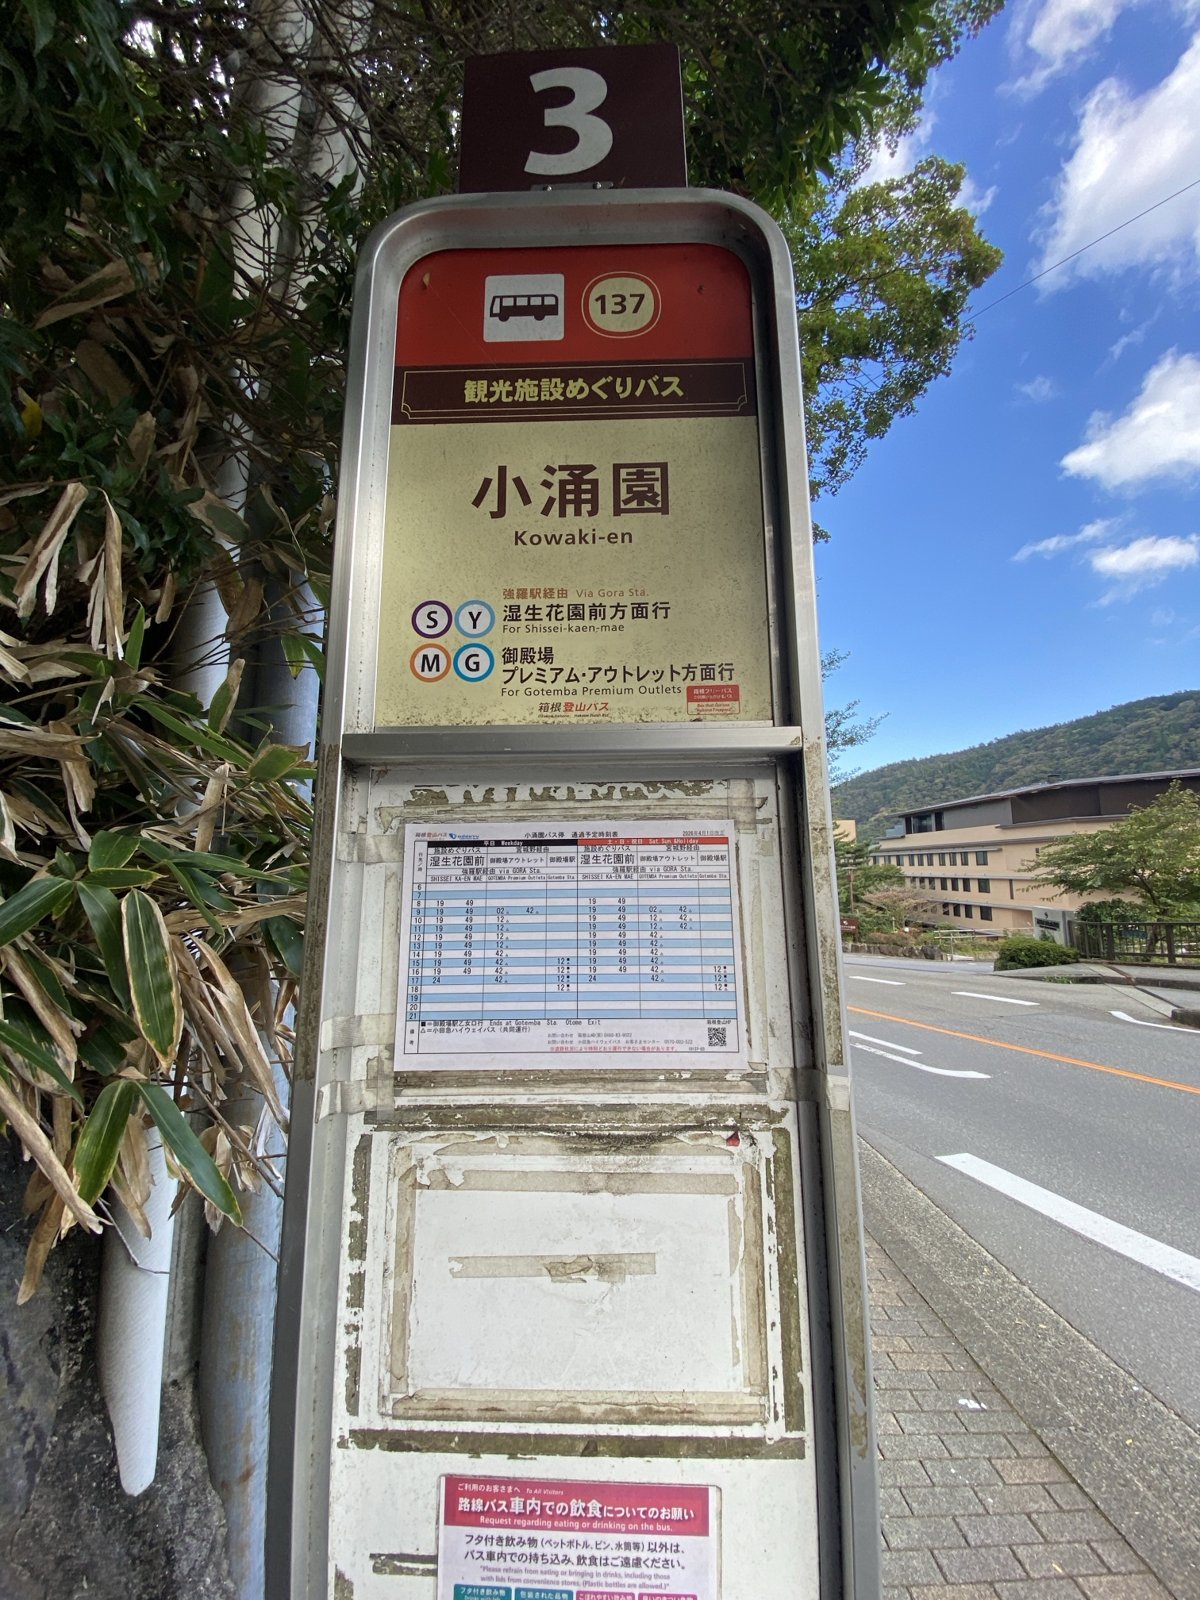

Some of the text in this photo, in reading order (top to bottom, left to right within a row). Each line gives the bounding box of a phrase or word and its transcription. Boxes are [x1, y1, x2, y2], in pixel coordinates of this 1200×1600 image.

[524, 66, 613, 176] 3
[594, 293, 645, 315] 137
[464, 375, 684, 404] 観光施設めぐりバス
[471, 461, 670, 519] 小涌園
[514, 529, 634, 546] Kowaki-en
[502, 588, 568, 600] 強羅駅経由
[576, 588, 649, 598] Via Gora Sta.
[426, 610, 482, 630] S Y
[502, 602, 671, 622] 湿生花園前方面行
[503, 624, 625, 633] For Shissei-kaen-mae
[421, 654, 480, 672] M G
[502, 646, 554, 665] 御殿場
[502, 663, 735, 684] プレミアム・アウトレット方面行
[501, 685, 682, 696] For Gotemba Premium Outlets
[430, 856, 485, 867] 湿生花園前
[580, 854, 635, 864] 湿生花園前
[458, 1483, 521, 1493] ご利用のお客さまへ
[458, 1496, 695, 1520] 路線バス車内での飲食についてのお願い
[480, 1516, 511, 1525] Request
[513, 1519, 552, 1528] regarding
[554, 1520, 579, 1530] eating
[592, 1520, 626, 1531] drinking
[656, 1523, 673, 1531] bus.
